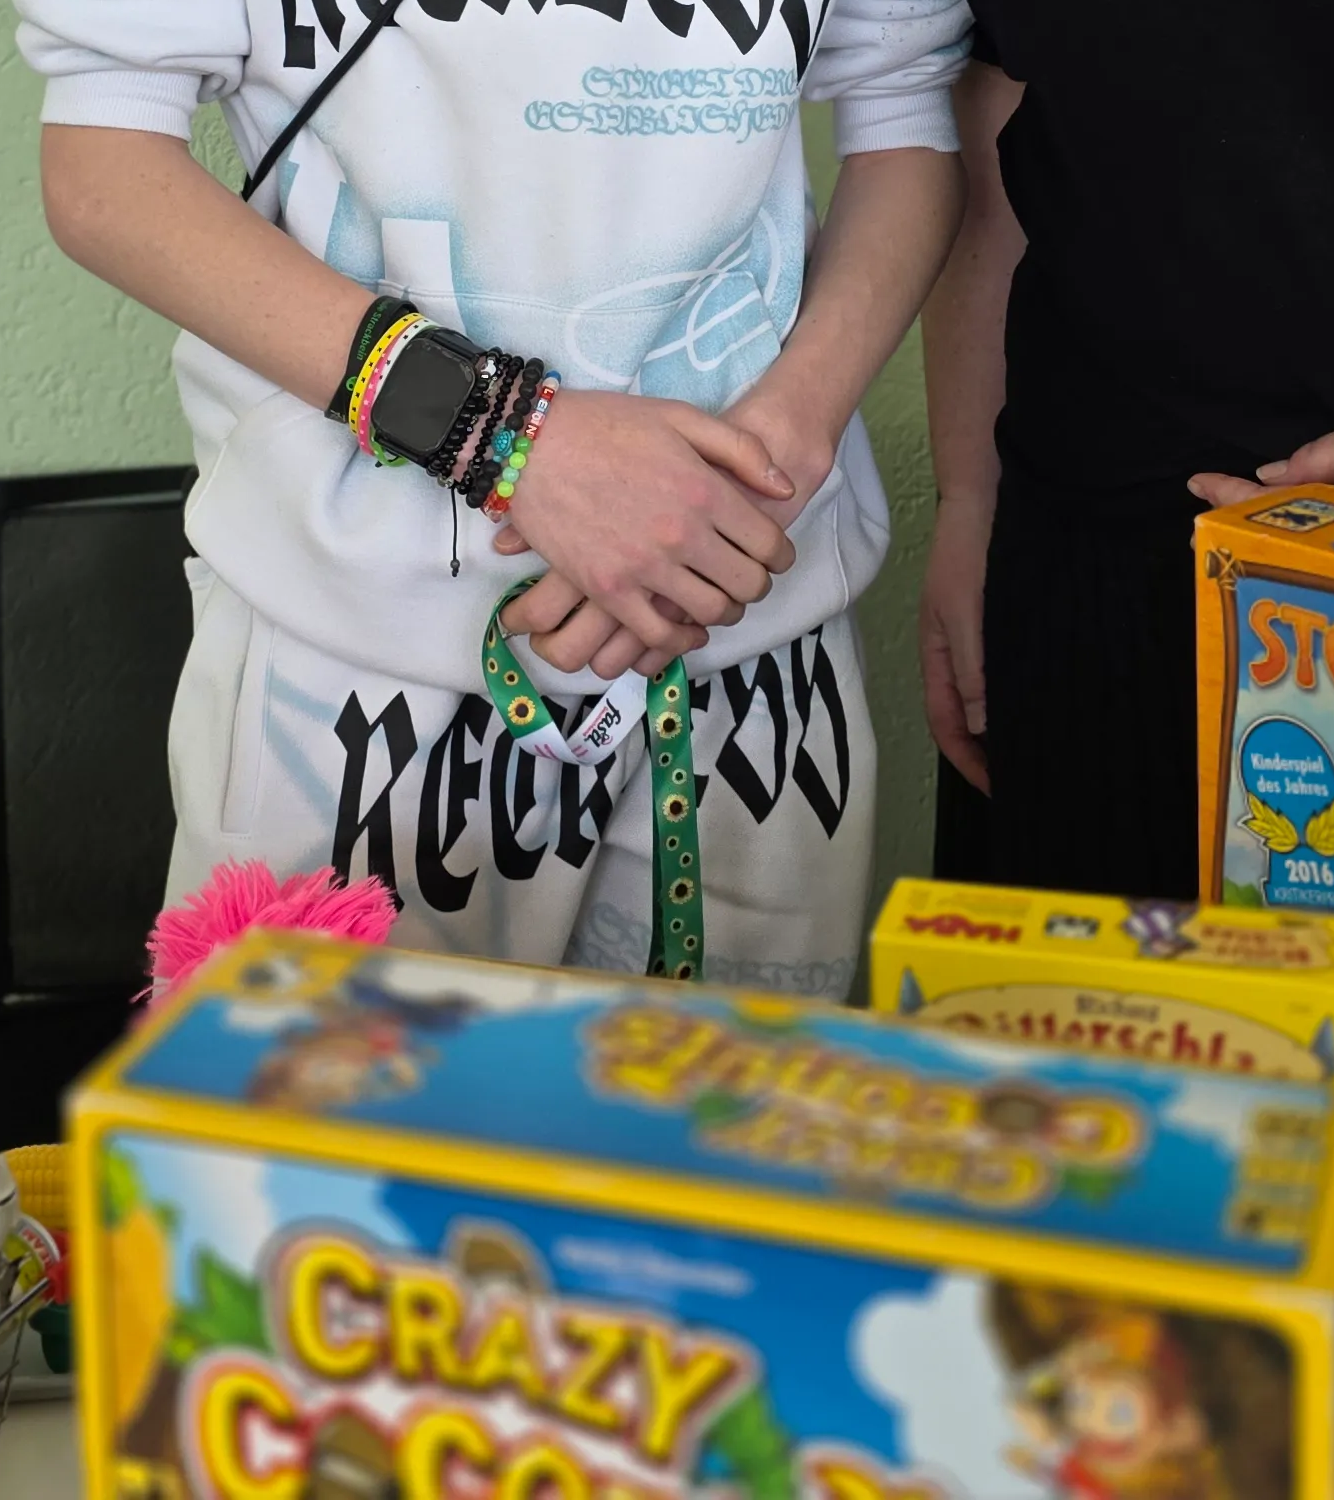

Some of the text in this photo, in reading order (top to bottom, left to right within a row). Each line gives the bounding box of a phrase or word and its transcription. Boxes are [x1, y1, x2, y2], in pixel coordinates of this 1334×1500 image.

[357, 312, 382, 360] Strackbein
[584, 697, 622, 747] fasd
[329, 624, 850, 913] RECKSS
[1250, 752, 1325, 775] Kinderspiel
[1257, 776, 1329, 797] des Jahres
[1285, 858, 1334, 886] 2016
[289, 1244, 739, 1463] CRAZY
